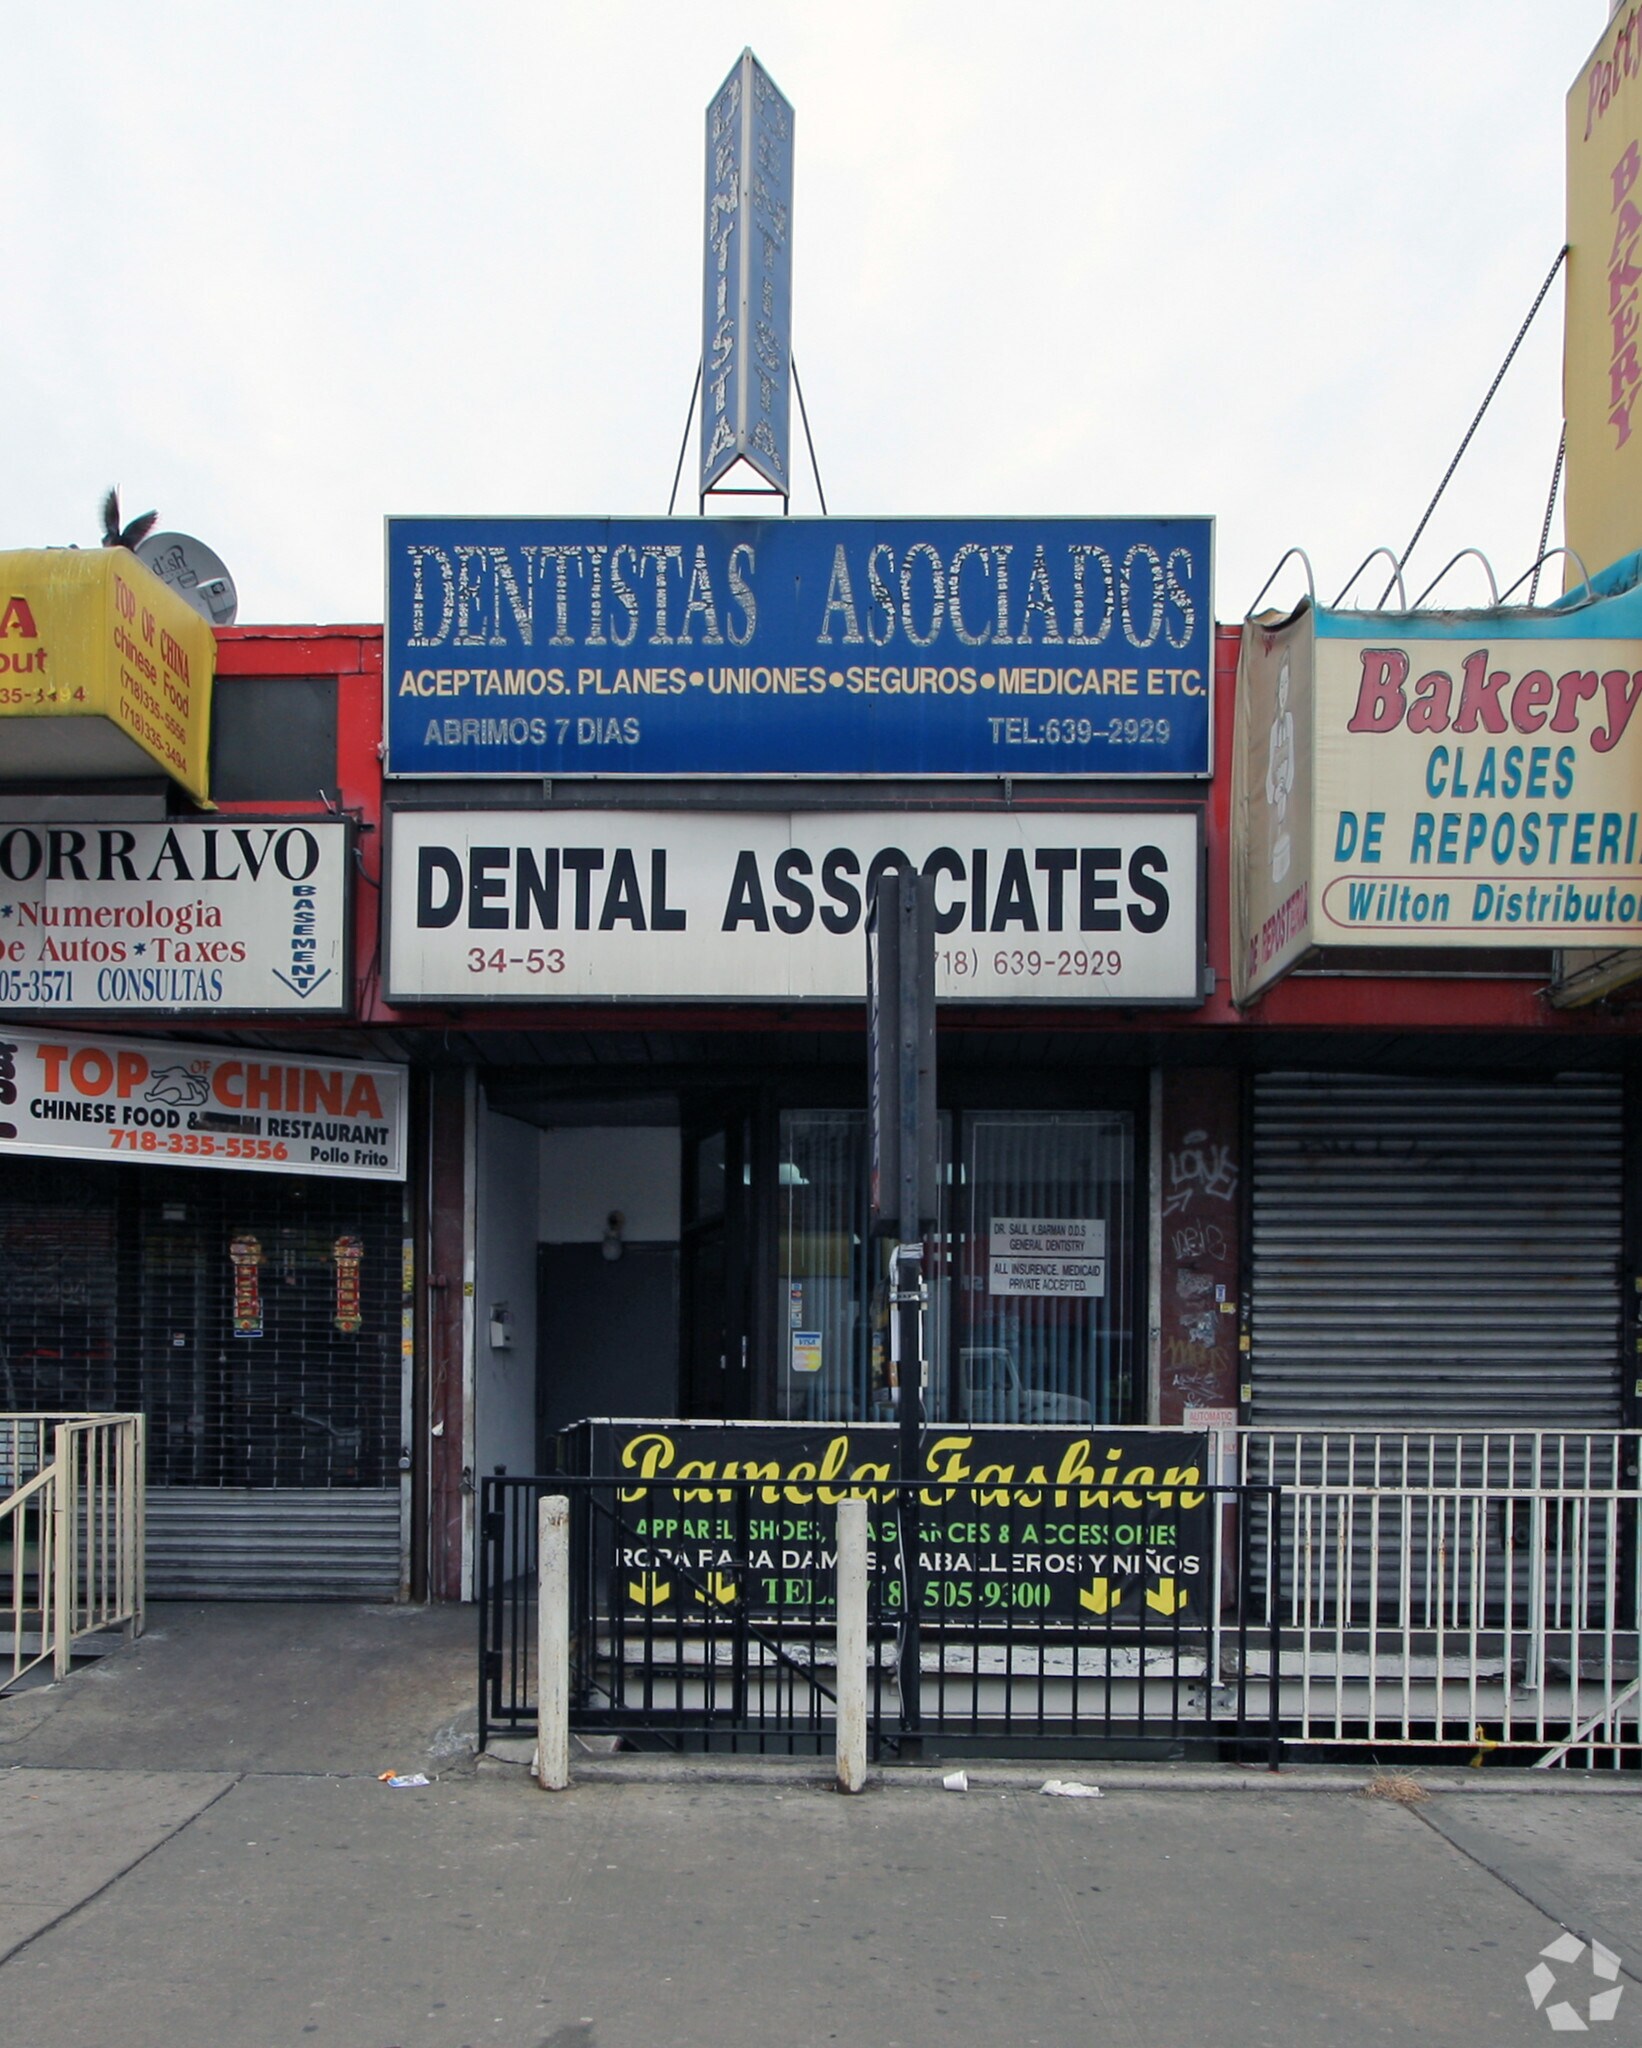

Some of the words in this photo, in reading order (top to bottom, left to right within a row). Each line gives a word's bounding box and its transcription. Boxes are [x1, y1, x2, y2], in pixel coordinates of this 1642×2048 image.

[704, 78, 742, 474] DENTISTA
[1608, 140, 1642, 451] BAKERY
[407, 543, 758, 647] DENTISTAS
[816, 543, 1196, 648] ASOCIADOS
[114, 573, 136, 625] TOP
[142, 606, 155, 648] OF
[161, 628, 190, 689] CHINA
[164, 670, 189, 719] Food
[399, 668, 571, 697] ACEPTAMOS.
[578, 668, 687, 695] PLANES
[708, 667, 828, 695] UNIONES
[846, 666, 977, 695] SEGUROS
[999, 668, 1138, 696] MEDICARE
[1147, 669, 1207, 697] ETC.
[1346, 648, 1642, 753] Bakery
[424, 718, 547, 746] ABRIMOS
[554, 718, 570, 746] 7
[577, 717, 641, 746] DIAS
[1425, 745, 1576, 800] CLASES
[0, 827, 320, 882] ORRALVO
[1333, 810, 1386, 864] DE
[1409, 811, 1642, 866] REPOSTERI
[416, 845, 687, 931] DENTAL
[1347, 882, 1450, 922] Wilton
[17, 900, 223, 935] Numerologia
[290, 884, 318, 989] BASEMENT
[0, 939, 26, 963] e
[37, 935, 128, 963] Autos
[150, 937, 247, 963] Taxes
[467, 947, 566, 974] 34-53
[933, 948, 978, 978] 18)
[993, 949, 1122, 977] 639-2929
[0, 969, 73, 1003] 05-3571
[97, 966, 224, 1003] CONSULTAS
[36, 1044, 149, 1098] TOP
[191, 1060, 211, 1075] OF
[212, 1060, 384, 1120] CHINA
[30, 1098, 117, 1125] CHINESE
[123, 1105, 180, 1130] FOOD
[187, 1111, 198, 1130] &
[267, 1117, 389, 1146] RESTAURANT
[108, 1128, 289, 1162] 718-335-5556
[310, 1146, 350, 1164] Pollo
[354, 1149, 389, 1167] Frito
[1009, 1239, 1043, 1251] GENERAL
[1046, 1240, 1085, 1252] DENTISTRY
[994, 1263, 1008, 1275] ALL
[1062, 1265, 1101, 1277] MEDICAID
[1009, 1278, 1040, 1290] PRIVATE
[1190, 1411, 1233, 1422] AUTOMATIC
[617, 1433, 897, 1506] Pamela
[918, 1435, 1206, 1510] Fashion
[998, 1524, 1010, 1544] &
[782, 1550, 887, 1574] DAMS,
[1088, 1554, 1107, 1574] Y
